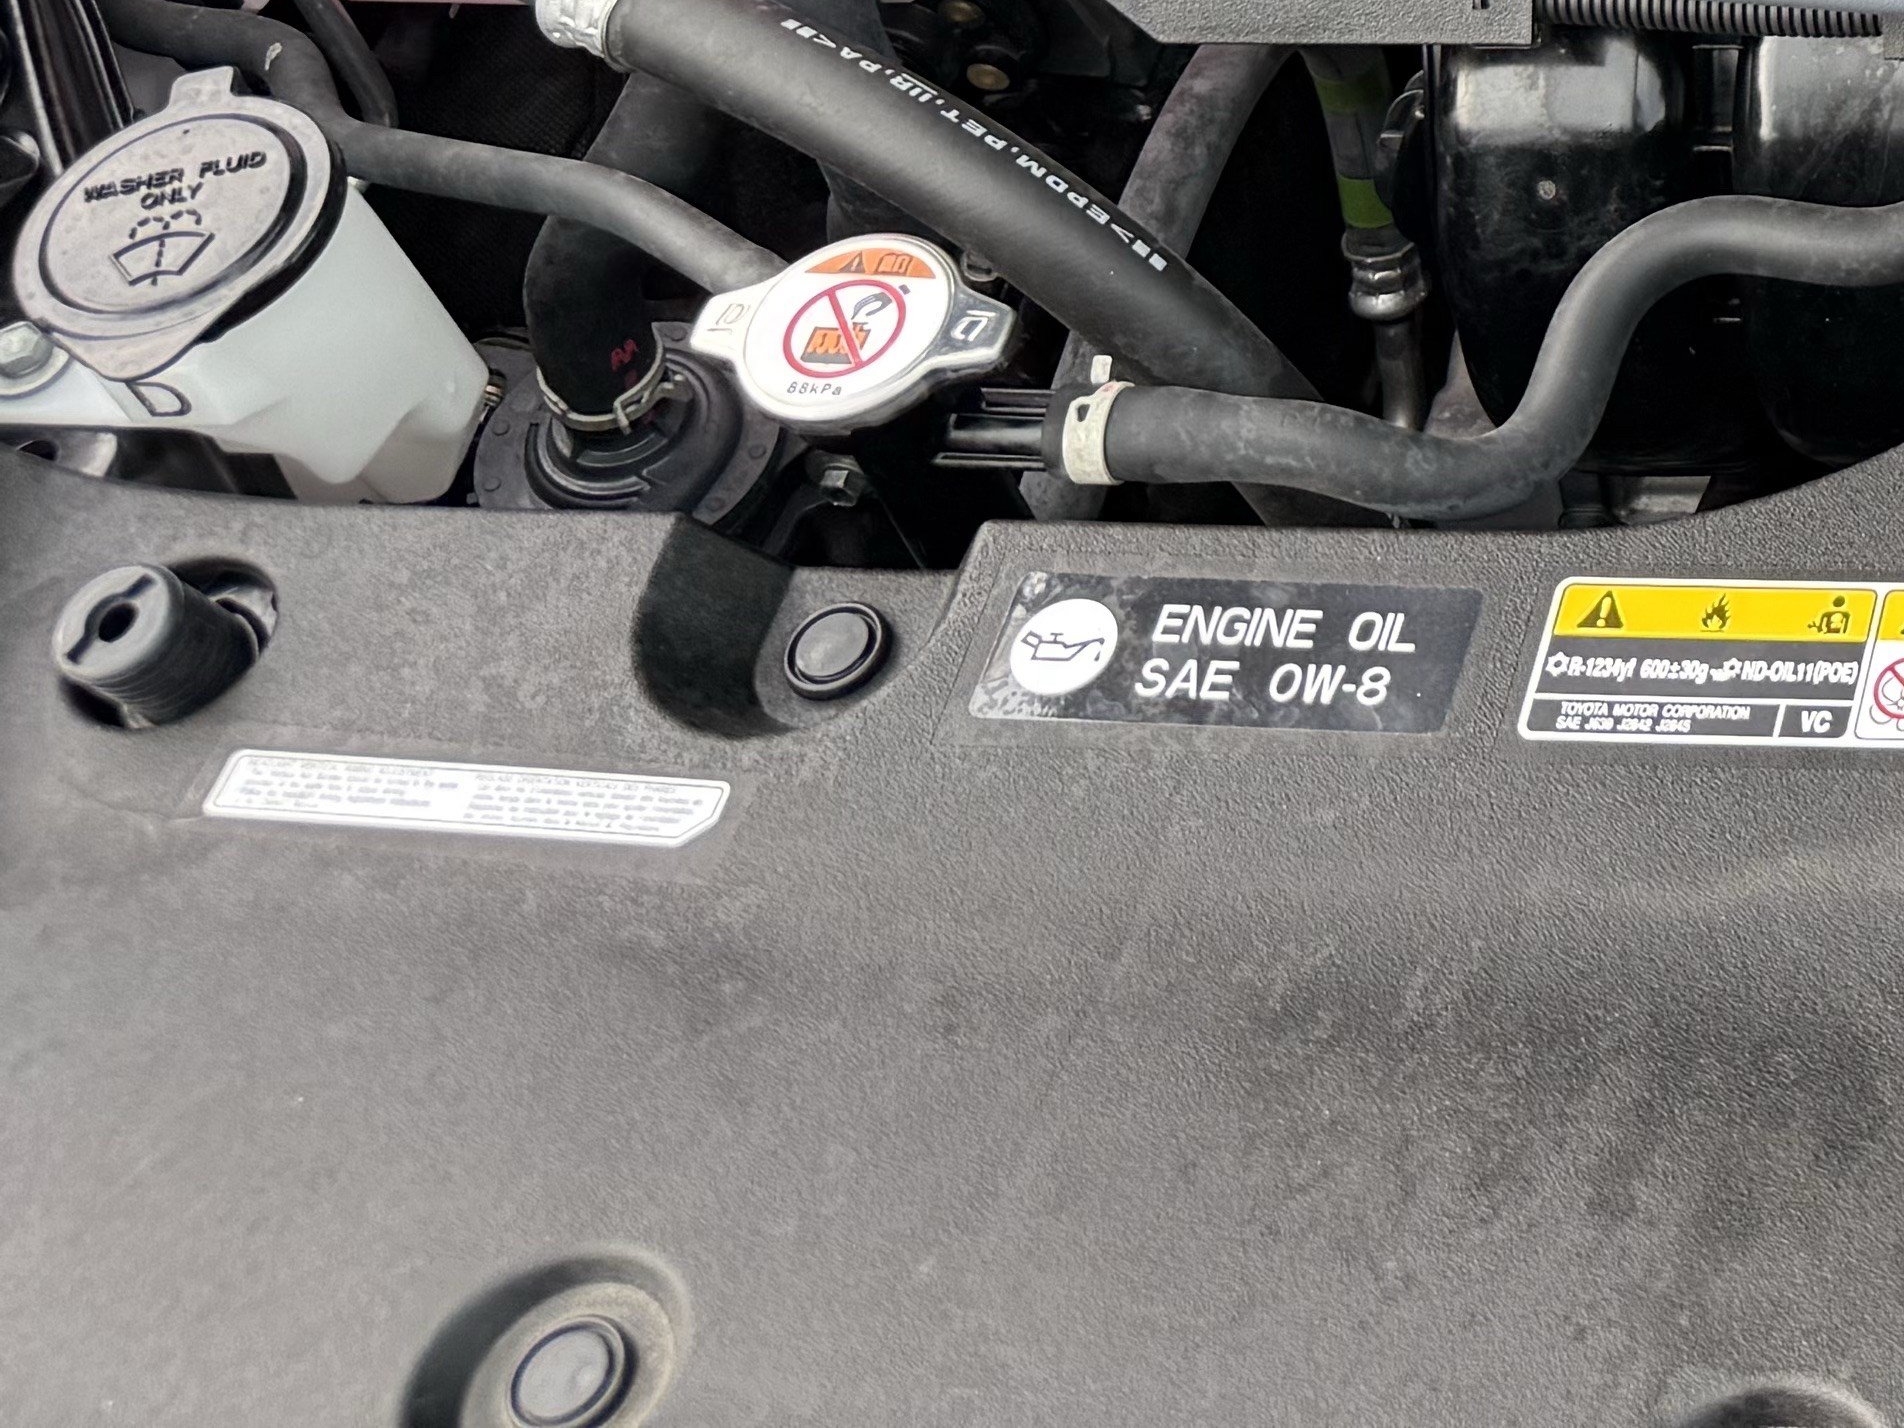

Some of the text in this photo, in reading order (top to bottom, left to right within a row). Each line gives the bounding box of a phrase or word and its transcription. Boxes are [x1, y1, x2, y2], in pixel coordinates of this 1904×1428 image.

[83, 150, 268, 204] WASHER FLUID
[140, 180, 205, 211] ONLY
[1152, 603, 1417, 653] ENGINE OIL
[1134, 658, 1392, 706] SAE 0W-8
[1556, 716, 1581, 731] SAE
[1561, 700, 1751, 720] TOYOTA MOTOR CORPORATION
[1801, 710, 1833, 734] VC
